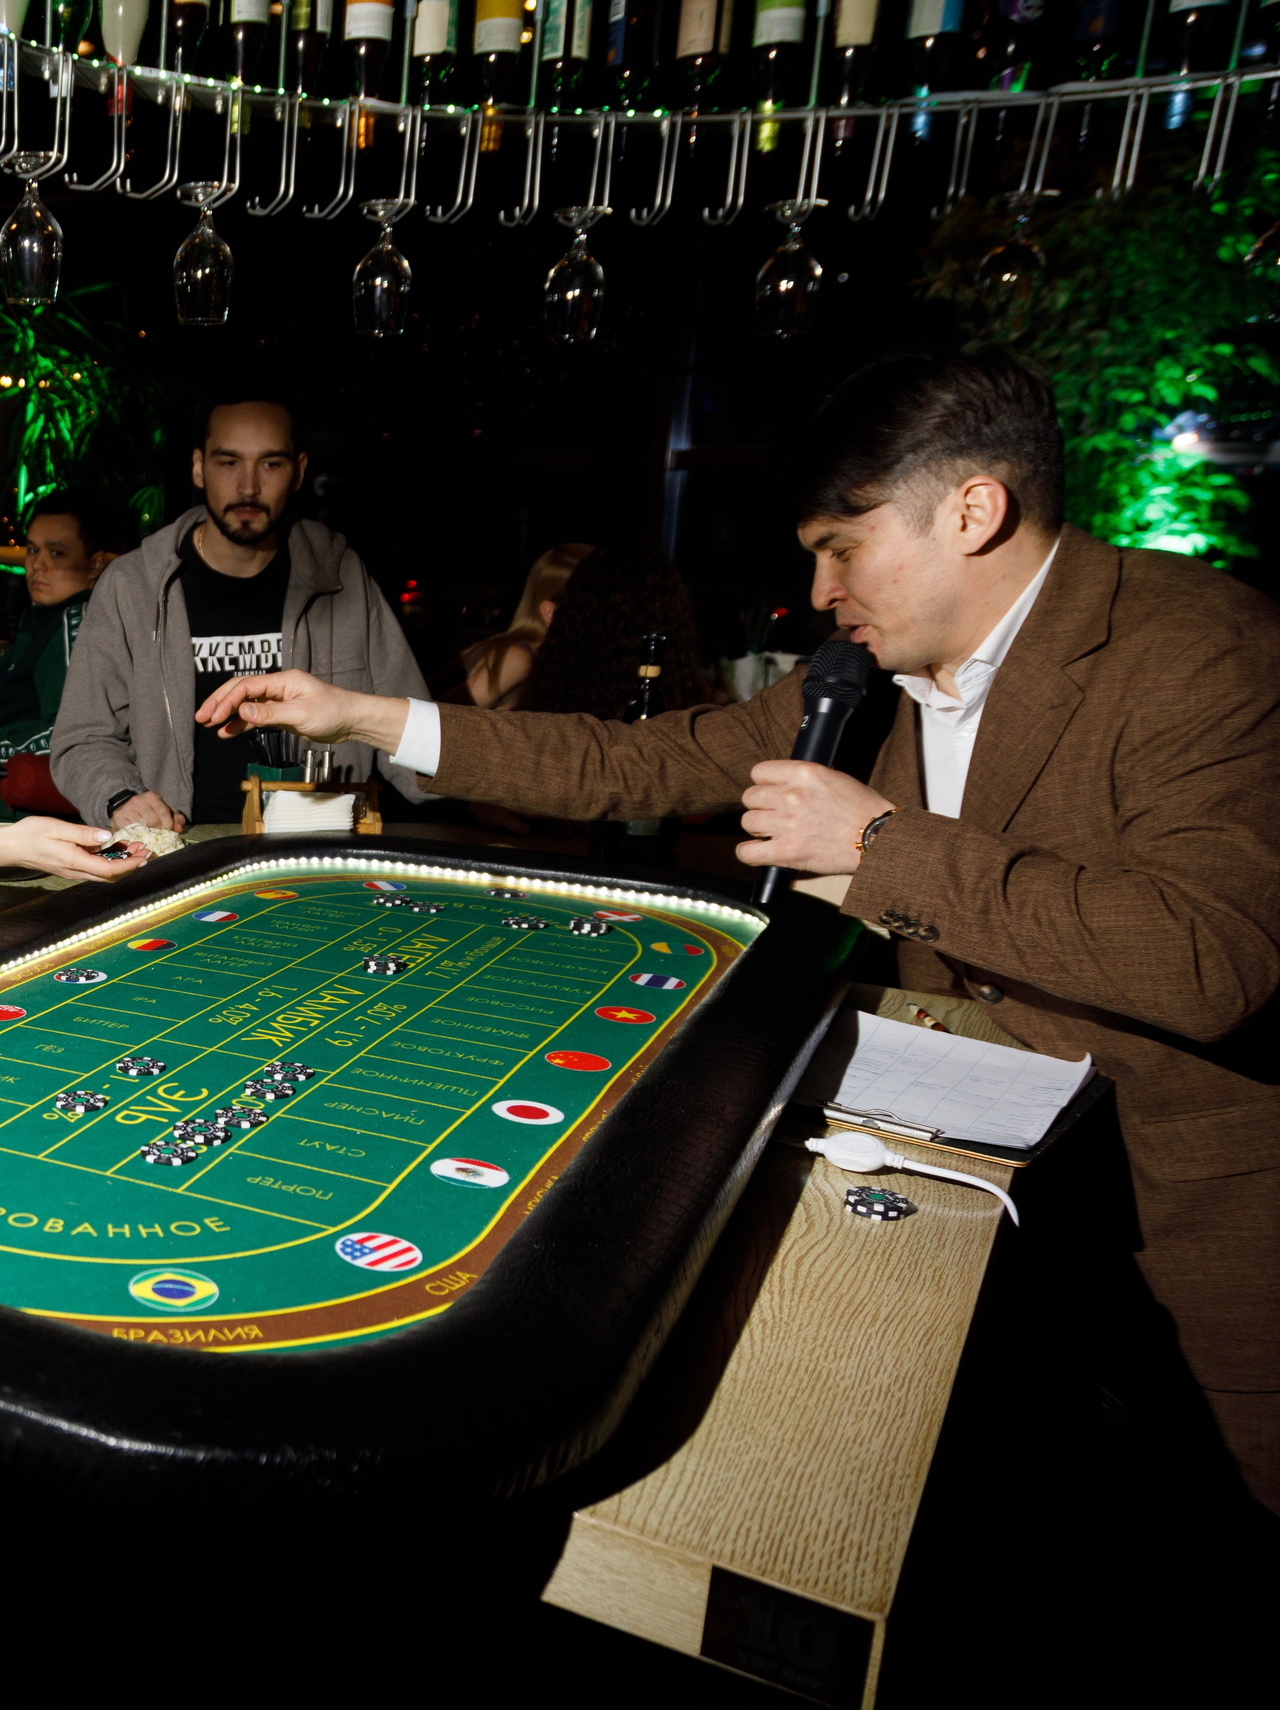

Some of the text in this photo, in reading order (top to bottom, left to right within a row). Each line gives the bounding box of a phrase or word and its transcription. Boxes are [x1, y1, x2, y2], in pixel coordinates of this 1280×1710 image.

[801, 715, 809, 728] 2
[386, 934, 450, 968] ЛАГЕ
[241, 984, 364, 1047] ЛАМБИК
[466, 997, 554, 1014] РИСОВОЕ
[73, 1017, 129, 1028] БИТТЕР
[431, 1019, 530, 1038] ЯЧМЕННОЕ
[34, 1044, 64, 1053] ГЁЗ
[392, 1041, 504, 1065] ФРУКТОВОЕ
[351, 1068, 478, 1096] ПШЕНИЧНОЕ
[115, 1083, 208, 1124] ЭЛЬ
[324, 1102, 425, 1125] ПИЛСНЕР
[298, 1139, 365, 1157] СТАУТ
[247, 1176, 333, 1200] ПОРТЕР
[424, 1269, 479, 1296] США
[111, 1324, 264, 1344] БРАЗИЛИЯ
